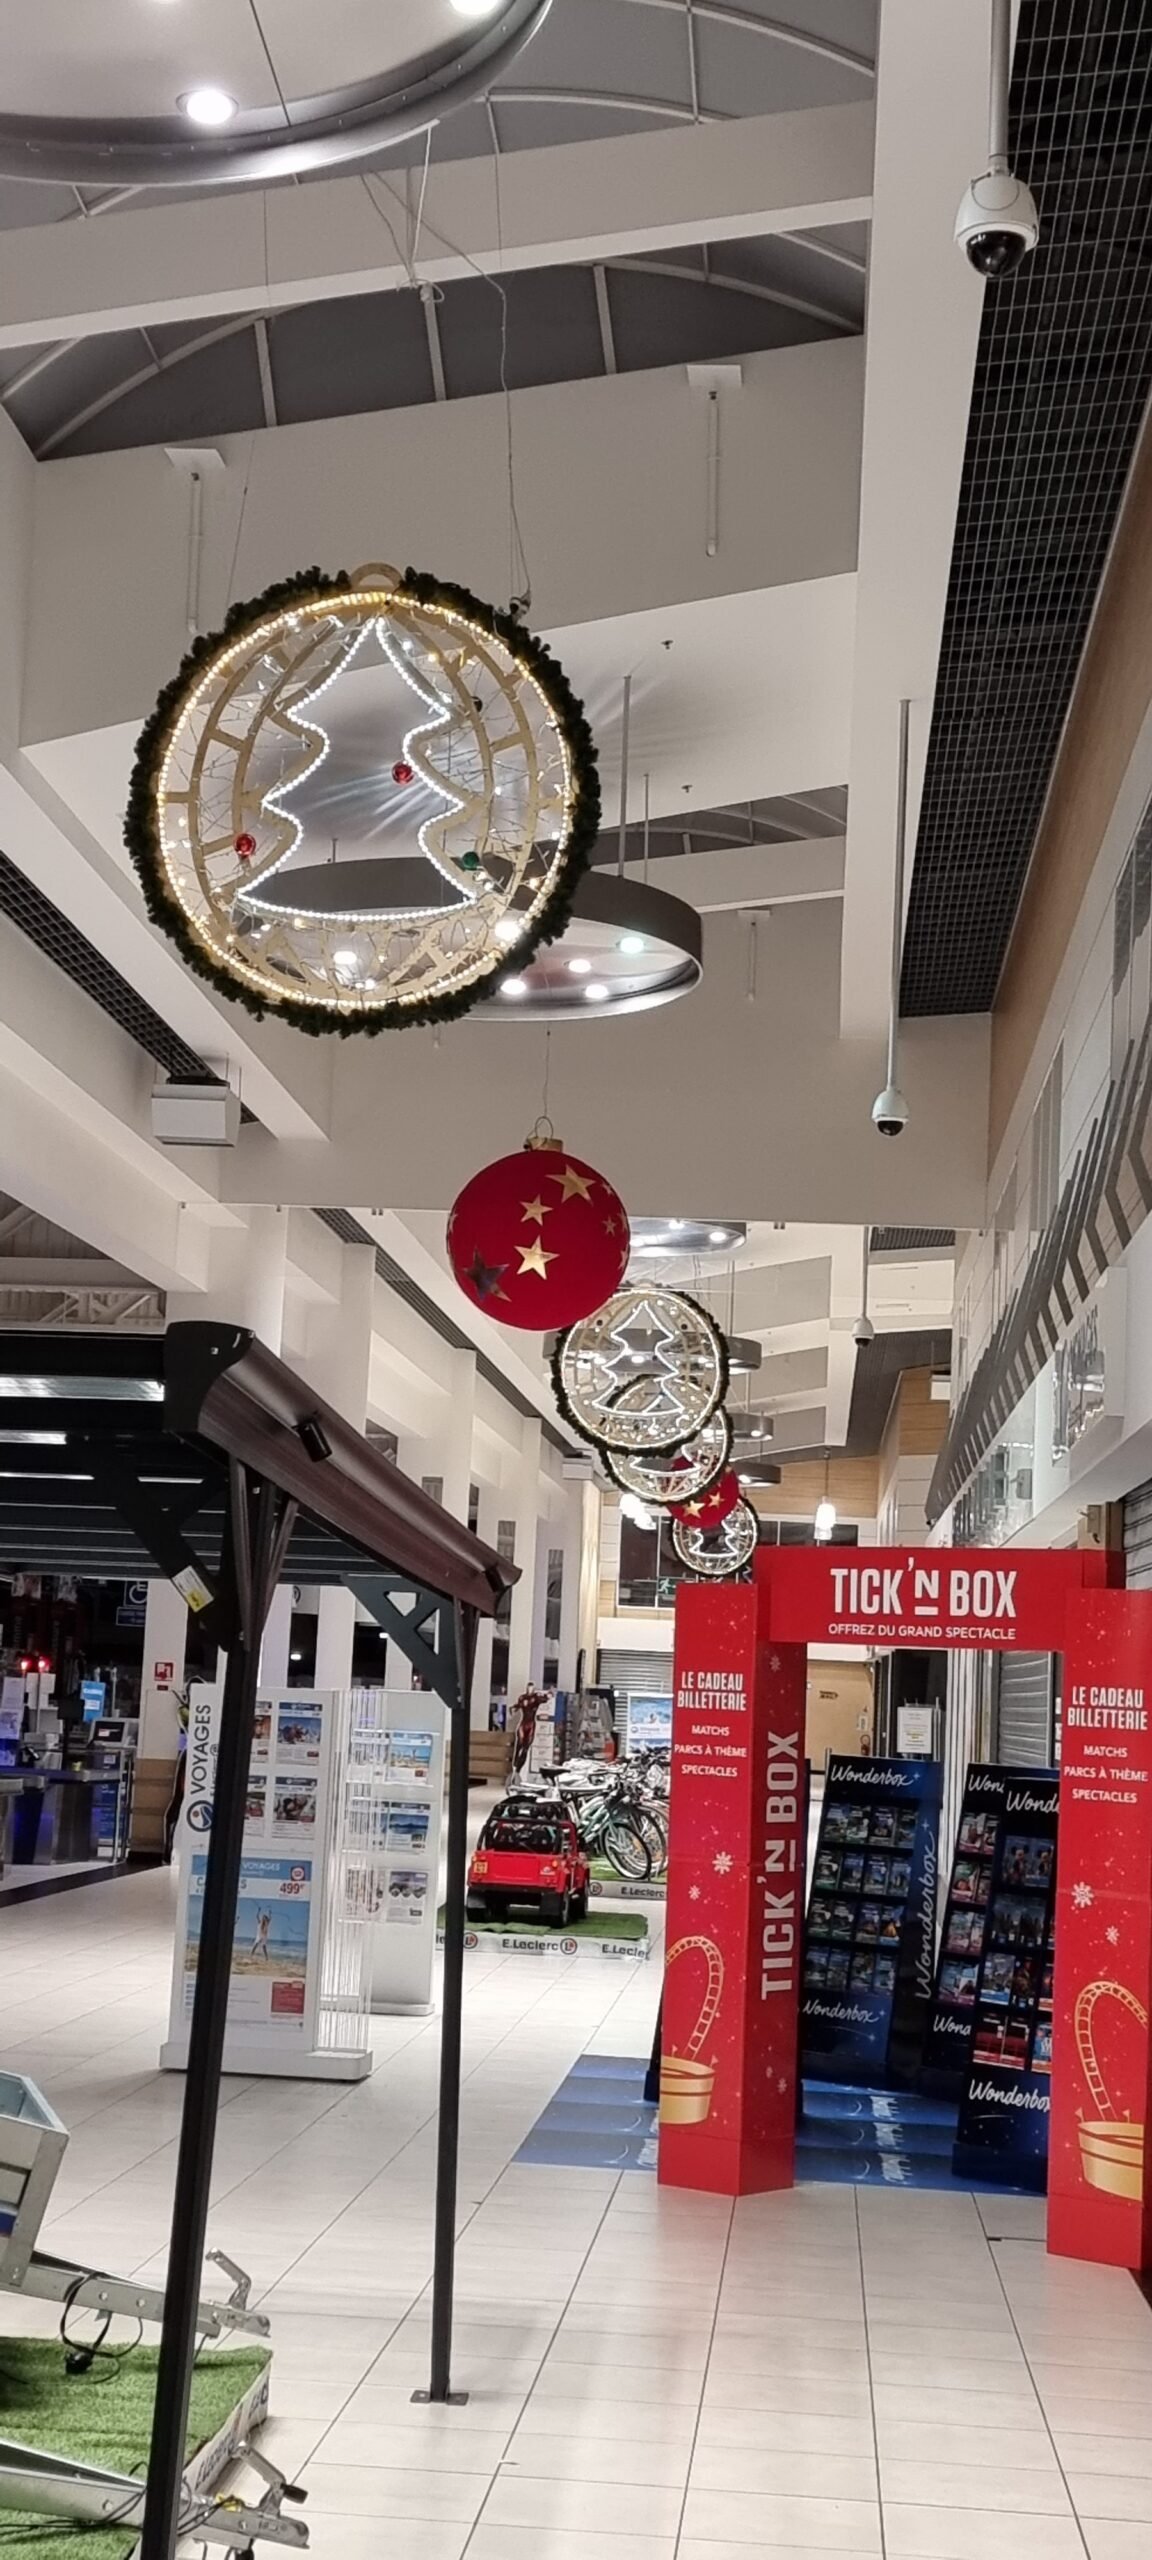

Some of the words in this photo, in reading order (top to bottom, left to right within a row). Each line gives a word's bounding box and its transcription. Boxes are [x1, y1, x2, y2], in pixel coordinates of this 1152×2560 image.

[950, 1570, 1017, 1617] BOX
[828, 1623, 875, 1636] OFFREZ
[878, 1625, 895, 1636] DU
[898, 1625, 942, 1638] GRAND
[945, 1627, 1016, 1640] SPECTACLE
[681, 1671, 694, 1689] LE
[697, 1672, 743, 1691] CADEAU
[677, 1690, 747, 1711] BILLETTERIE
[1072, 1686, 1086, 1705] LE
[1089, 1687, 1143, 1708] CADEAU
[1067, 1707, 1148, 1730] BILLETTERIE
[691, 1725, 730, 1737] MATCHS
[190, 1704, 211, 1795] VOYAGES
[674, 1744, 702, 1755] PARCS
[704, 1744, 712, 1755] À
[714, 1745, 747, 1758] THÈME
[1083, 1745, 1128, 1758] MATCHS
[681, 1764, 738, 1777] SPECTACLES
[766, 1731, 799, 1823] BOX
[831, 1764, 914, 1787] Wonderbox
[1064, 1766, 1096, 1778] PARCS
[1098, 1767, 1107, 1779] À
[1109, 1768, 1149, 1782] THÈME
[1072, 1788, 1137, 1803] SPECTACLES
[914, 1830, 937, 1999] Wonderbox
[502, 1938, 559, 1951] E.Leclerc
